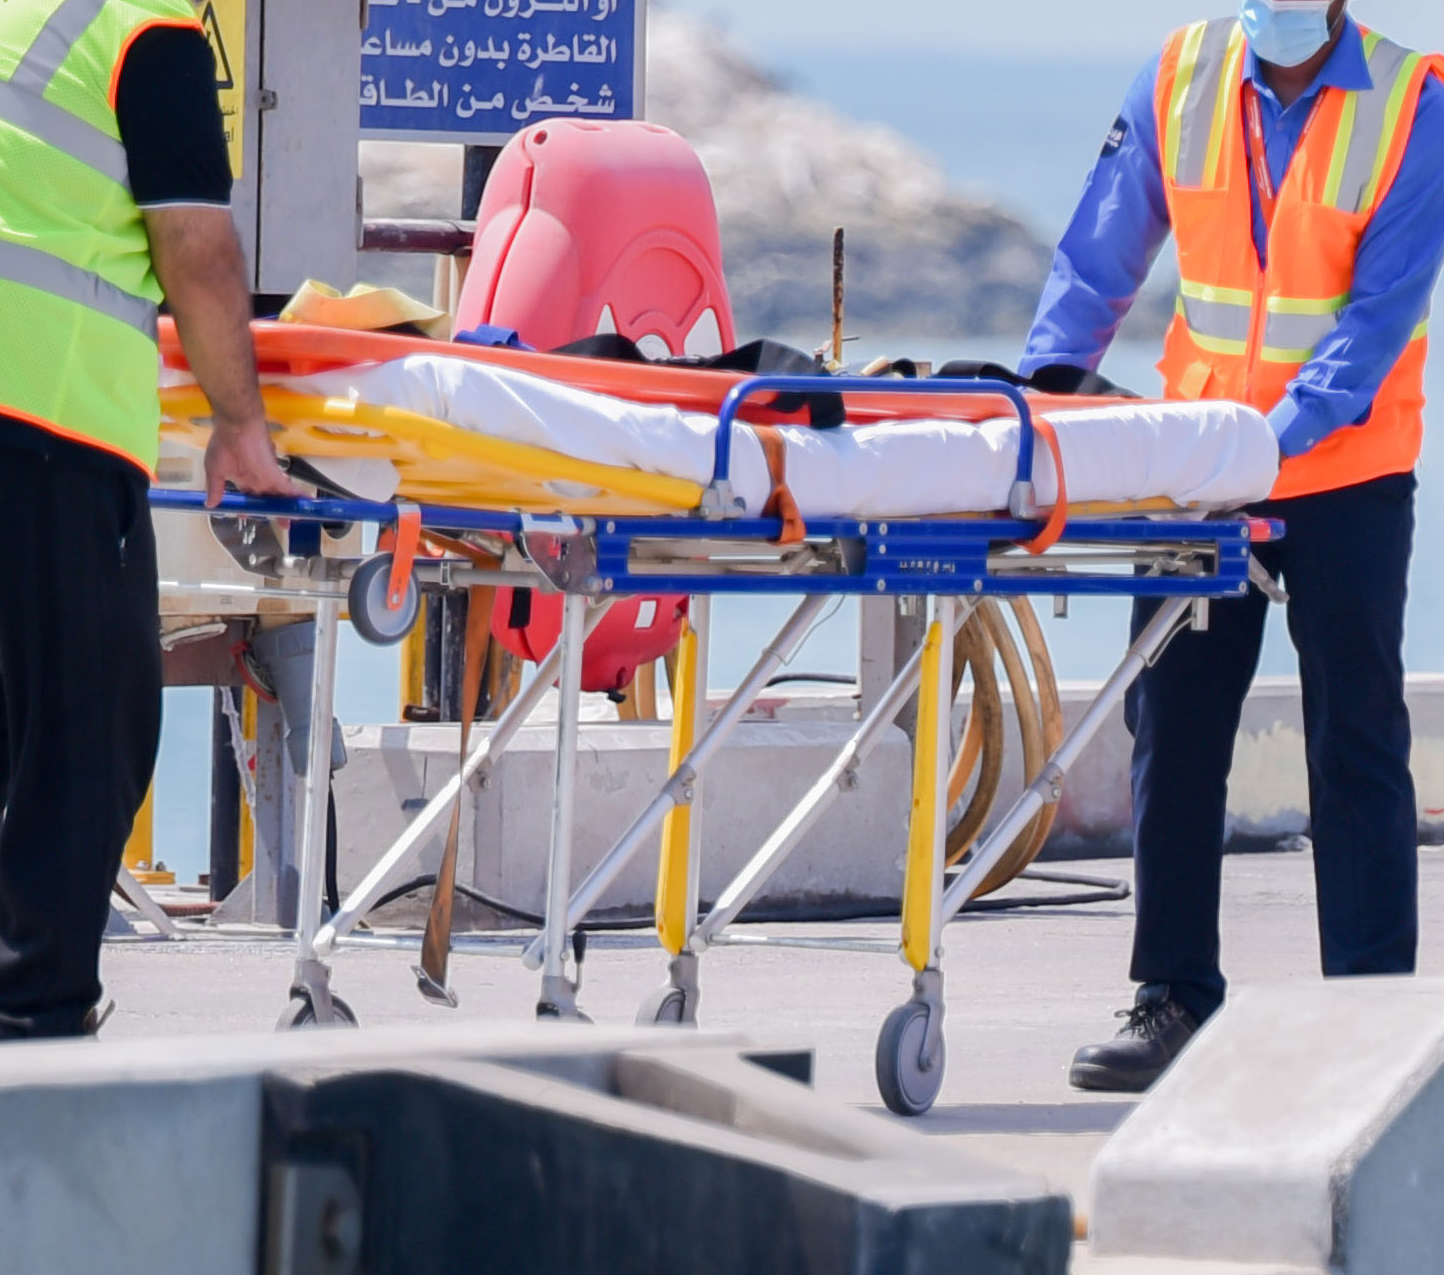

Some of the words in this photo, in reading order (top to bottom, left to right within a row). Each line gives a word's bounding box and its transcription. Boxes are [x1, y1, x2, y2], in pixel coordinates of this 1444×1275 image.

[438, 34, 511, 70] بدون
[516, 32, 617, 69] القاطرة
[456, 83, 505, 118] من
[510, 81, 615, 120] شخص
